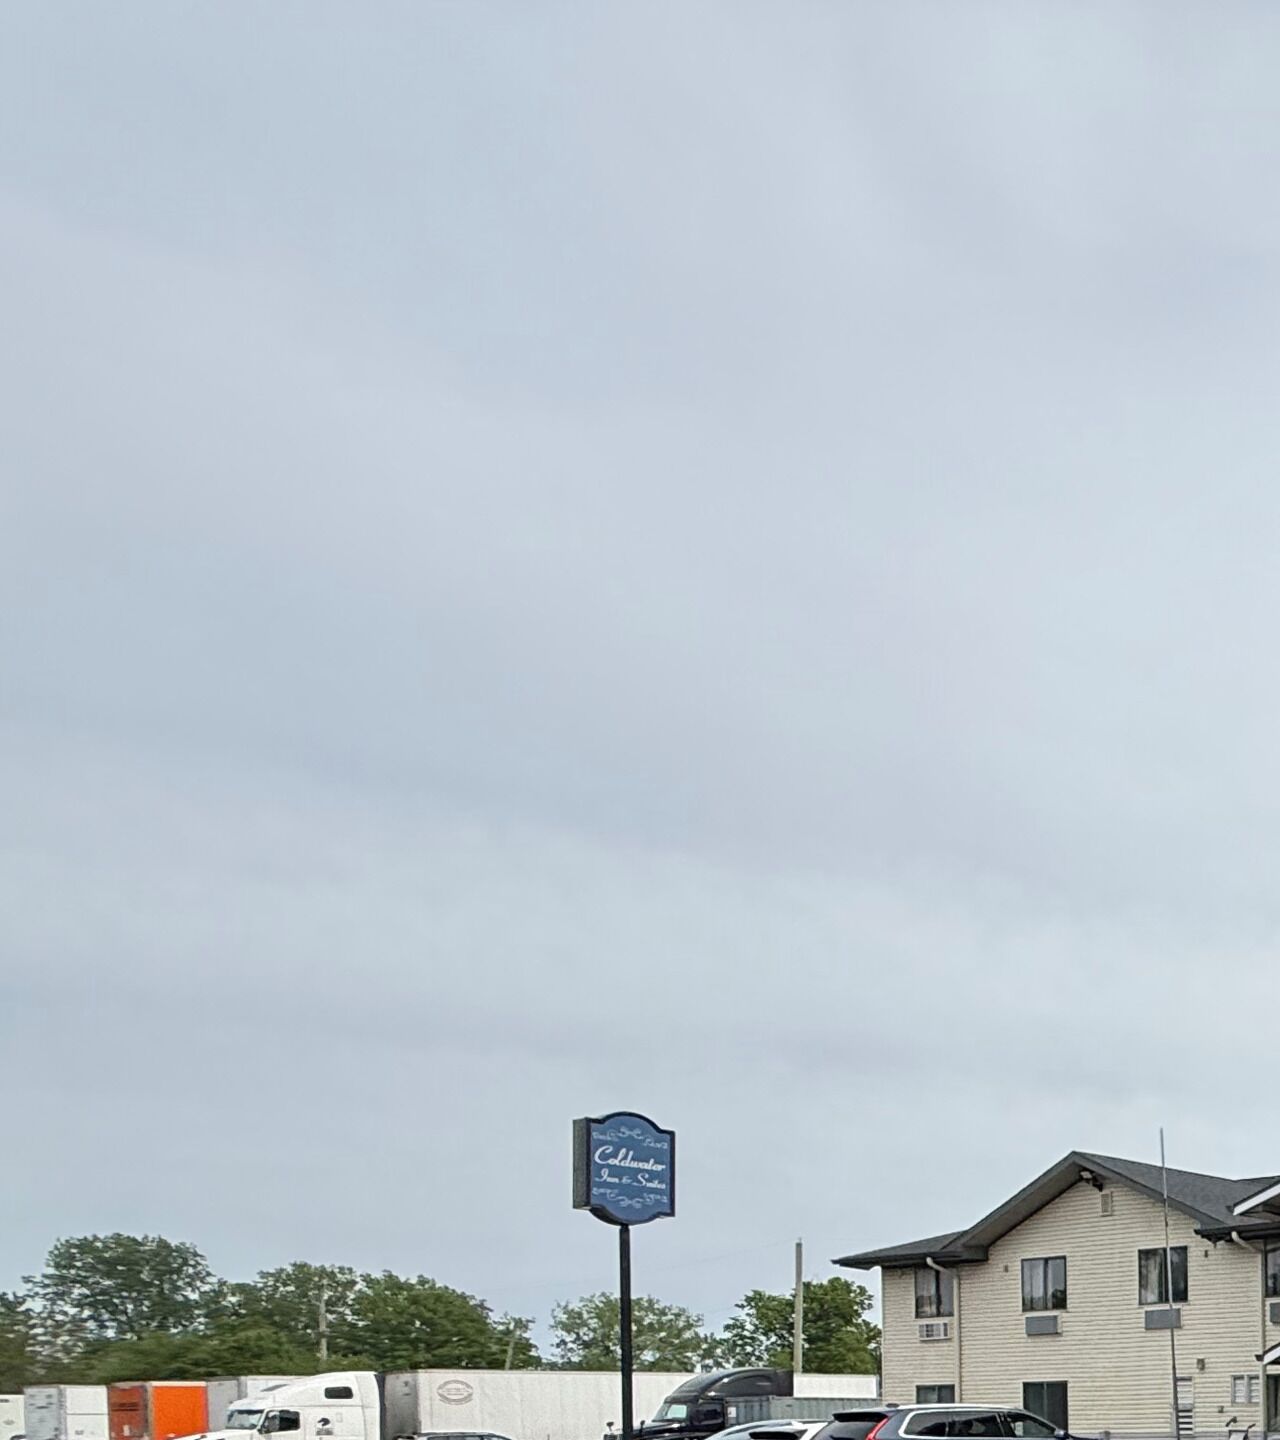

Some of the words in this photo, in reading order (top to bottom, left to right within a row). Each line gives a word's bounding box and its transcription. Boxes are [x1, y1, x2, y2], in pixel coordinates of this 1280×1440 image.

[594, 1145, 666, 1171] Coldwater
[595, 1168, 619, 1183] Inn
[621, 1176, 632, 1185] &
[632, 1172, 666, 1189] Suites
